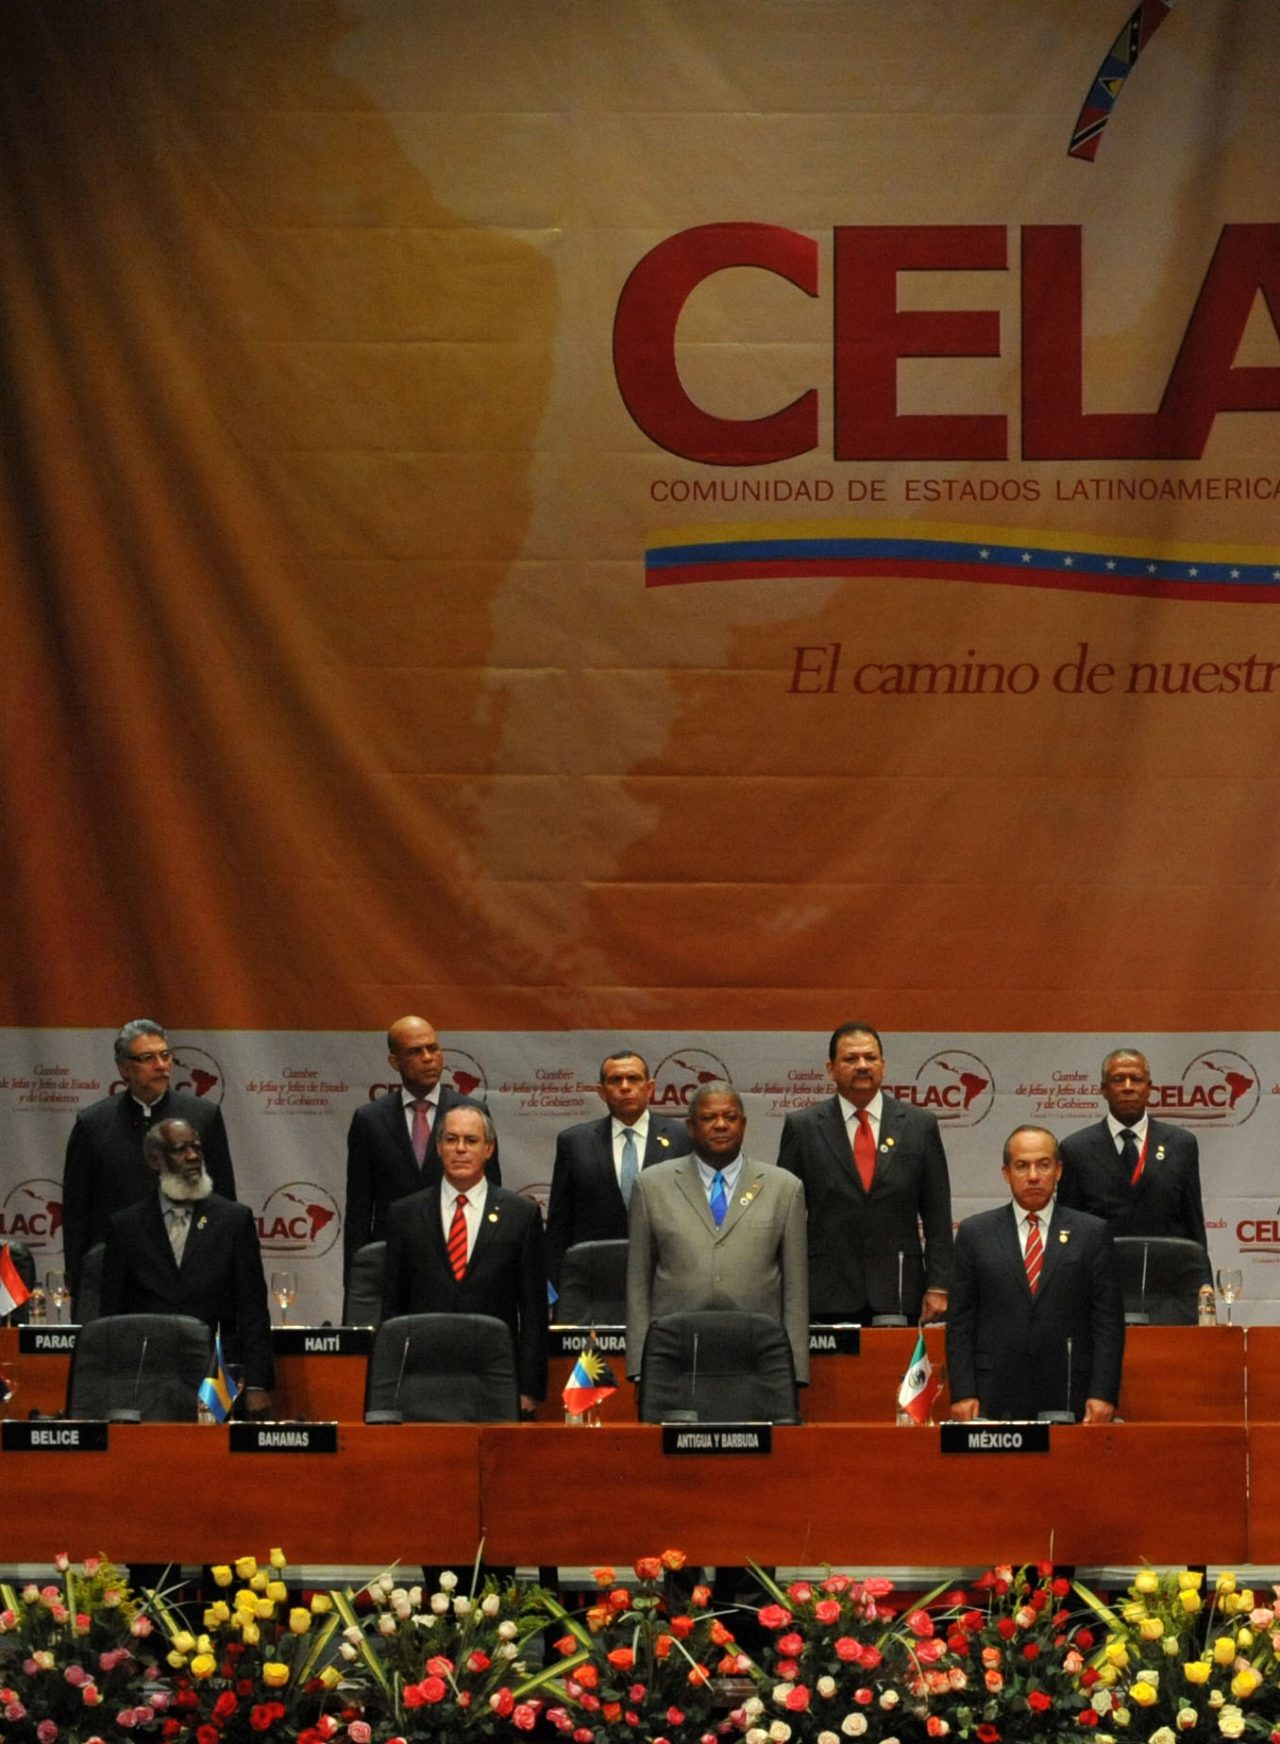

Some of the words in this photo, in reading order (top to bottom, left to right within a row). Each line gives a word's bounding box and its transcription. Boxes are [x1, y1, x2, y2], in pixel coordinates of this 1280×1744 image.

[649, 479, 835, 502] COMUNIDAD
[848, 479, 887, 502] DE
[905, 478, 1041, 502] ESTADOS
[785, 642, 842, 695] El
[853, 648, 1040, 695] camino
[1053, 642, 1115, 695] de
[254, 1216, 308, 1238] LAC
[304, 1334, 340, 1351] HAITÍ
[809, 1335, 837, 1349] ANA
[31, 1430, 80, 1445] BELICE
[258, 1431, 309, 1447] BAHAMAS
[677, 1433, 713, 1448] ANTIGUA
[713, 1433, 720, 1448] Y
[721, 1433, 759, 1448] BARBUDA
[968, 1430, 1023, 1448] MÉXICO
